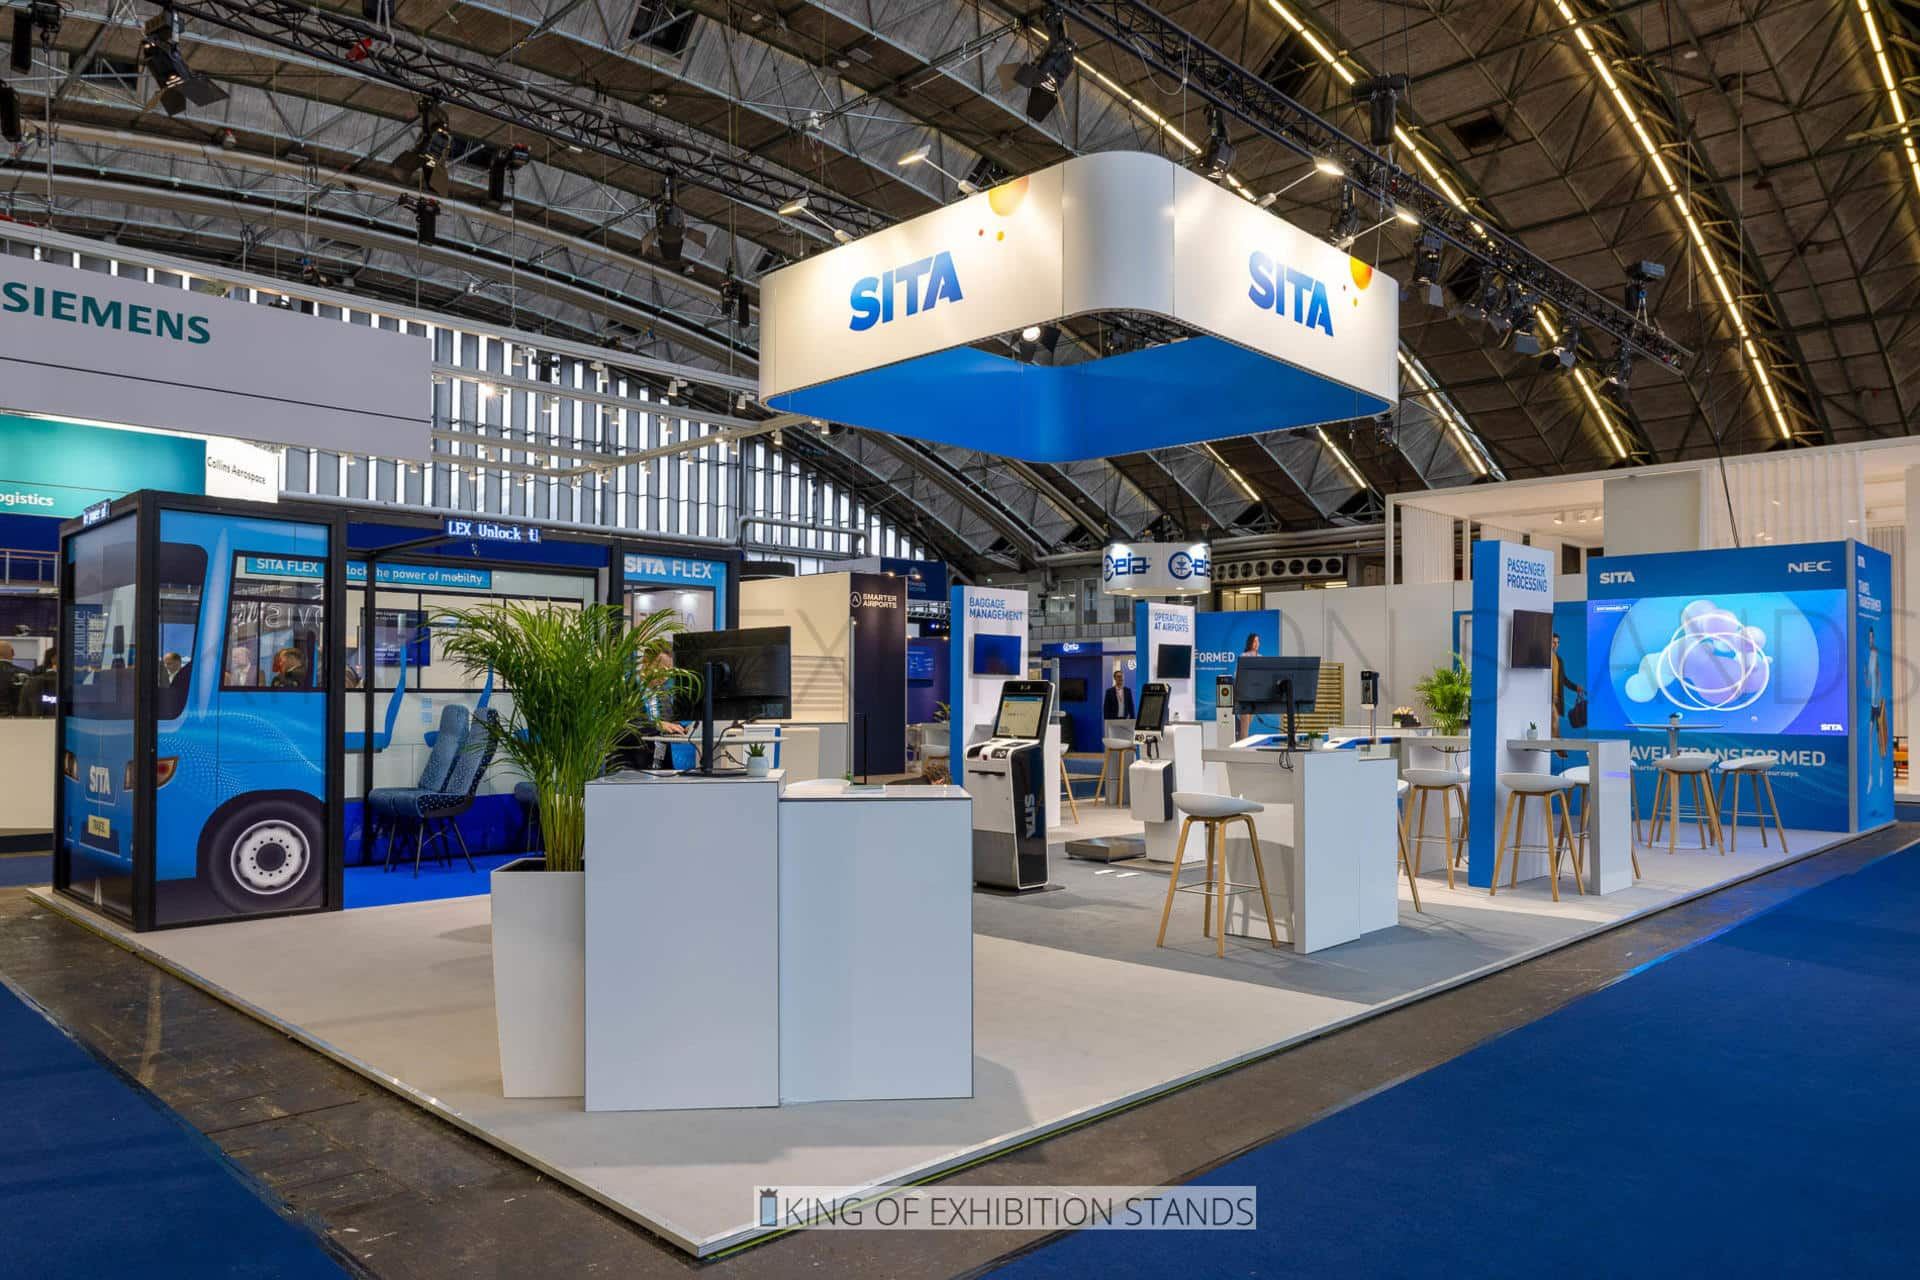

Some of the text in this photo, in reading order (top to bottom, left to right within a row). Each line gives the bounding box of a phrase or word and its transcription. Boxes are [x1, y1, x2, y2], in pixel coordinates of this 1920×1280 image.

[849, 250, 963, 332] SITA
[1248, 250, 1334, 337] SITA
[1, 281, 211, 345] SIEMENS
[448, 521, 472, 536] LEX
[478, 524, 521, 541] Unlock
[257, 558, 318, 573] SITA FLEX
[623, 555, 712, 579] SITA FLEX
[1507, 557, 1546, 578] PASSENGER
[1788, 560, 1832, 574] NEC
[392, 569, 428, 581] power
[428, 571, 439, 581] of
[441, 573, 483, 585] mobility
[1507, 573, 1547, 593] PROCESSING
[1600, 571, 1635, 585] SITA
[862, 593, 897, 602] SMARTER
[862, 600, 897, 609] AIRPORTS
[969, 596, 1006, 609] BAGGAGE
[969, 607, 1024, 621] MANAGEMENT
[89, 764, 112, 796] SITA
[1024, 793, 1037, 840] SITA
